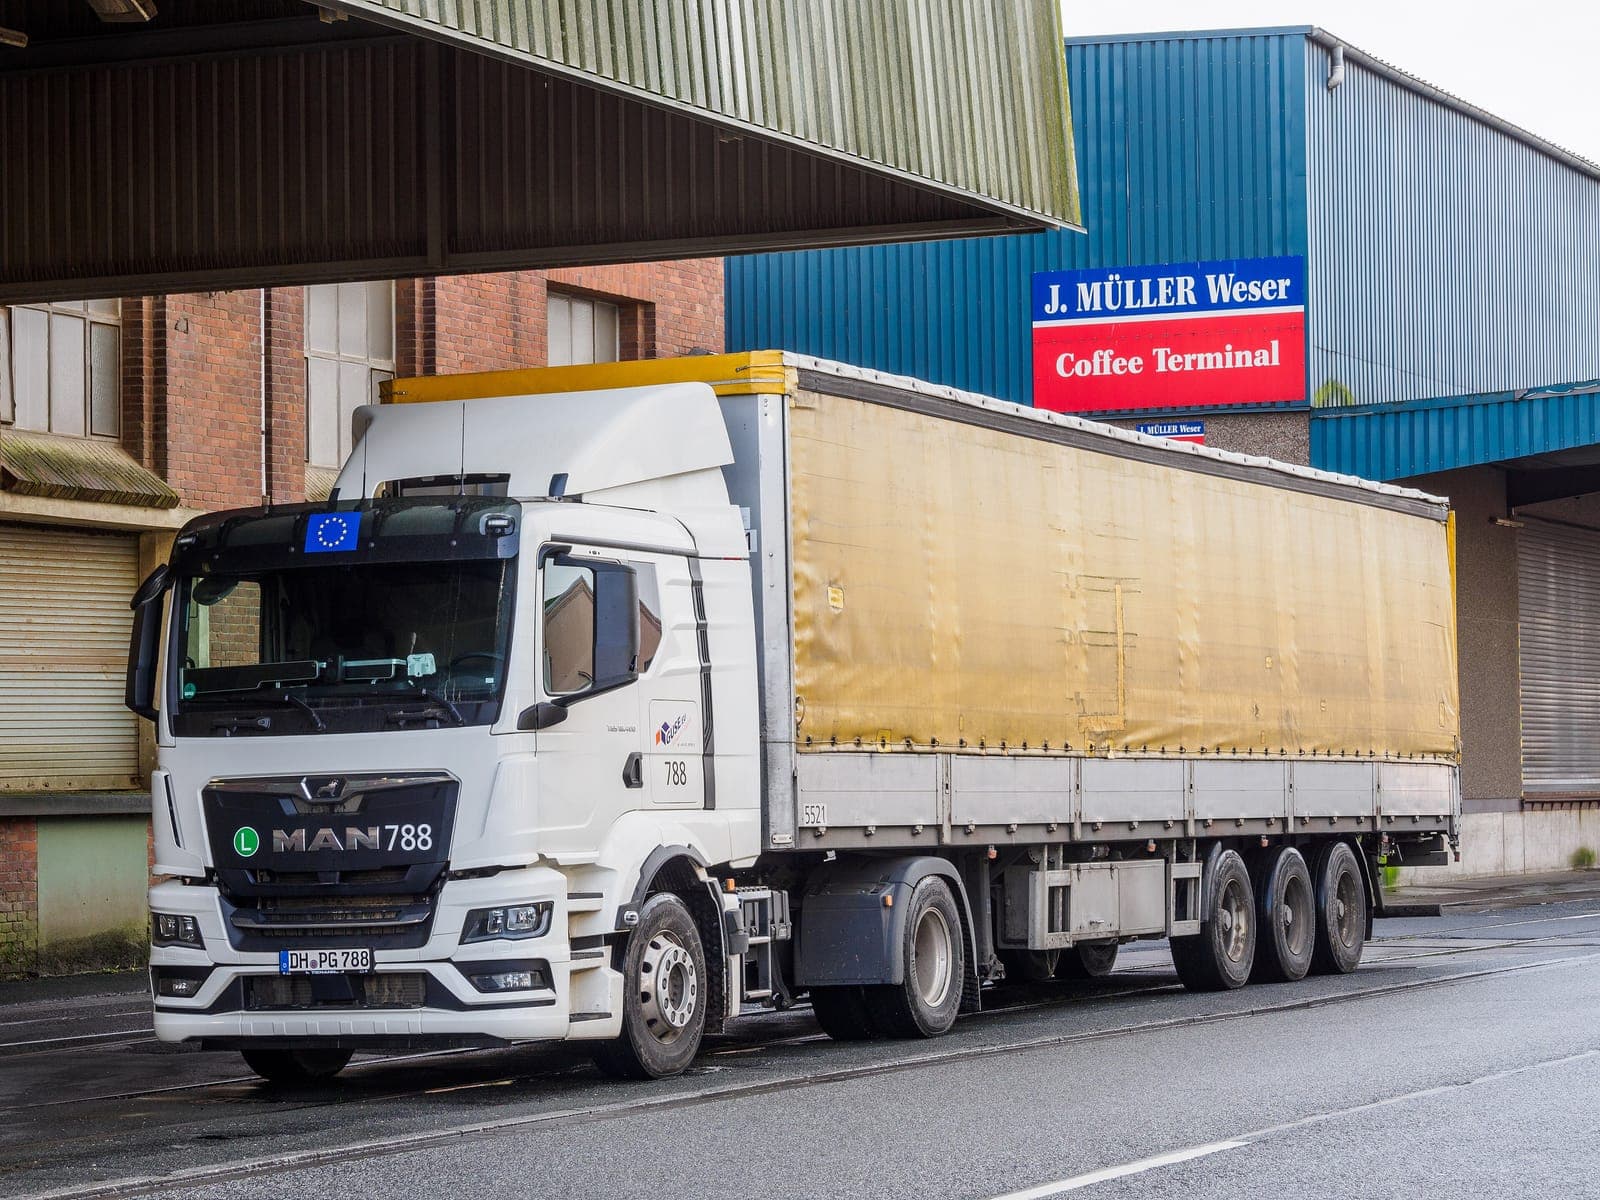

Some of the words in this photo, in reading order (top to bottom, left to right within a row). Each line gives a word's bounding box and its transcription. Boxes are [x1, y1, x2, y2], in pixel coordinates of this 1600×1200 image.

[1044, 285, 1068, 314] J.
[1076, 273, 1198, 313] MÜLLER
[1205, 273, 1291, 304] Weser
[1056, 349, 1144, 378] Coffee
[1153, 340, 1281, 373] Terminal
[1147, 424, 1178, 434] MÜLLER
[1180, 424, 1202, 433] Weser
[664, 761, 687, 786] 788
[805, 805, 826, 825] 5521
[240, 832, 252, 852] L
[272, 826, 380, 853] MAN
[384, 824, 433, 851] 788
[289, 952, 309, 969] DH
[319, 951, 338, 968] PG
[341, 950, 369, 968] 788
